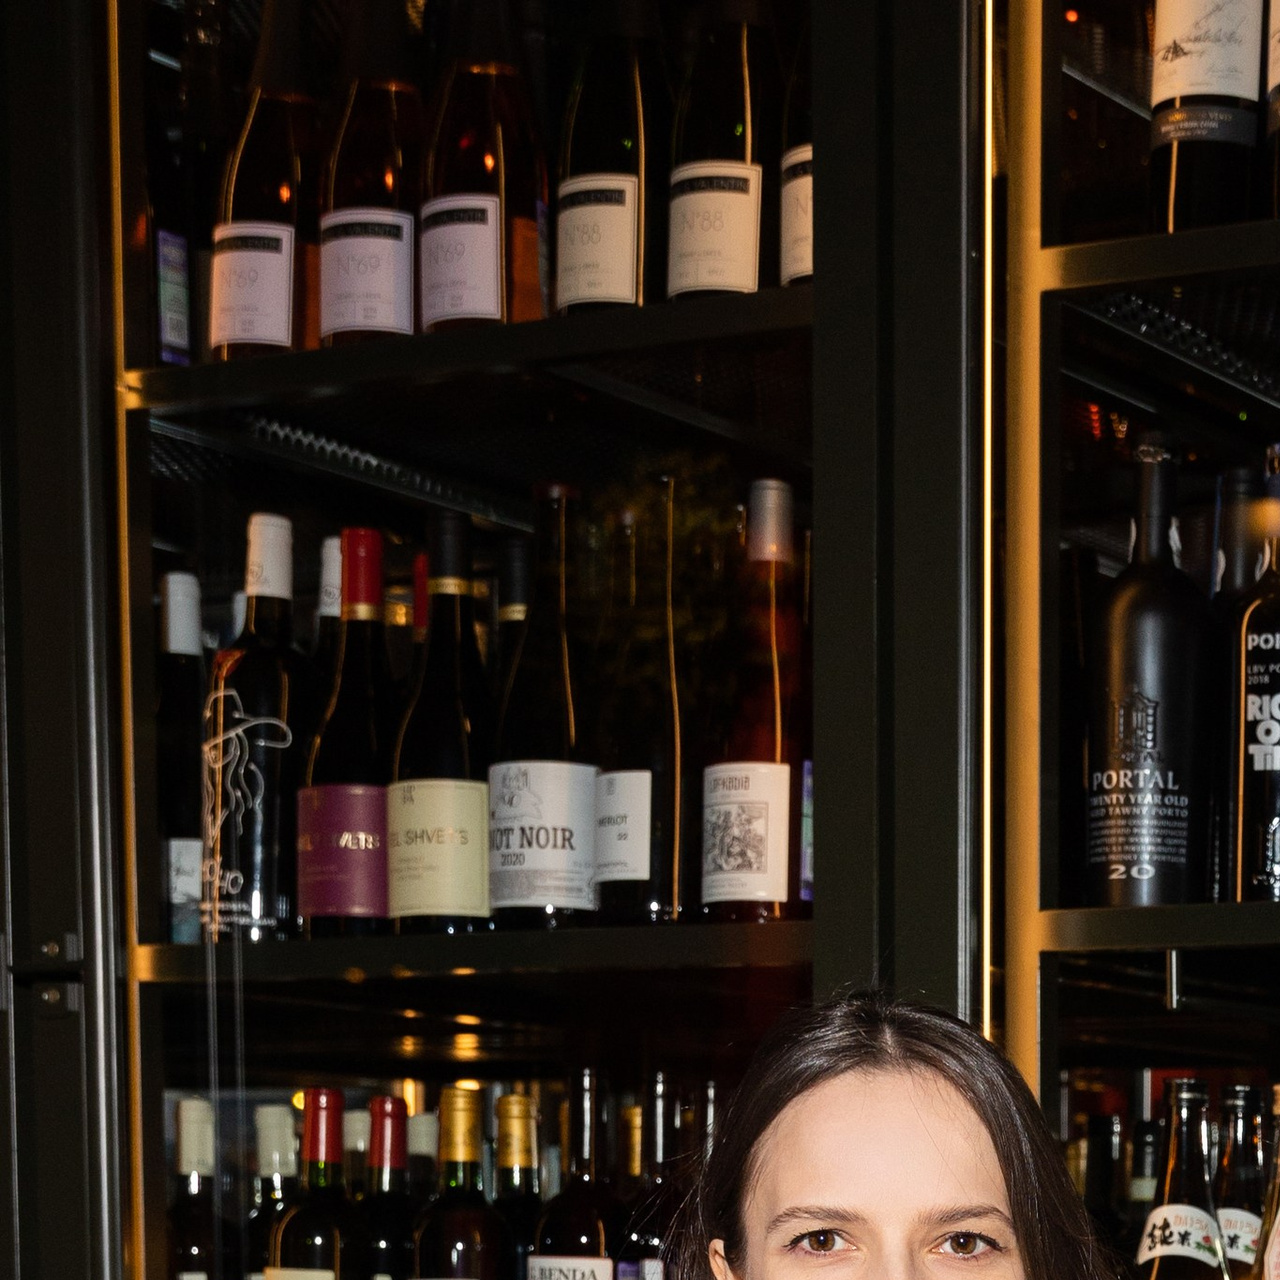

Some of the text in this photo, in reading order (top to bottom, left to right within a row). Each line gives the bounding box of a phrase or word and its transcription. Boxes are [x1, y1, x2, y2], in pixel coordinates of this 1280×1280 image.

[1092, 768, 1180, 792] PORTAL
[1163, 794, 1189, 808] OLD
[1108, 806, 1149, 817] TAWNY
[1150, 807, 1189, 818] PORTO
[405, 829, 470, 847] SHVES
[519, 826, 576, 851] NOIR
[500, 853, 526, 867] 2020
[1108, 863, 1156, 881] 20
